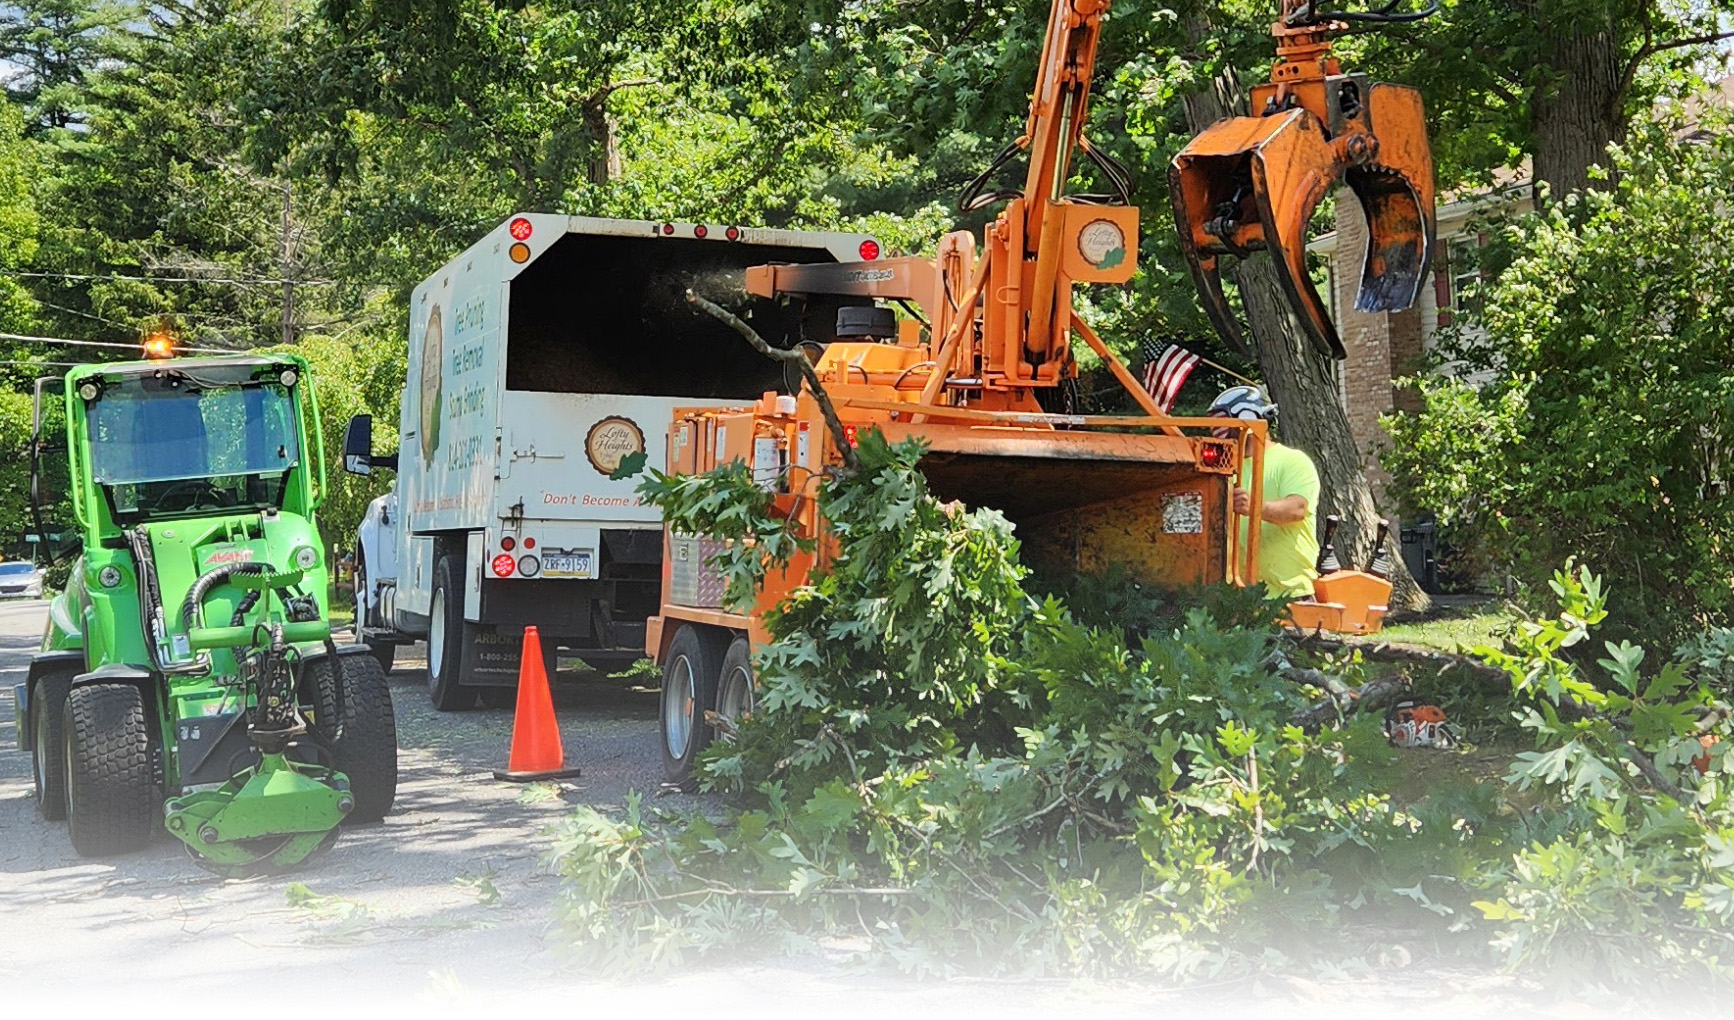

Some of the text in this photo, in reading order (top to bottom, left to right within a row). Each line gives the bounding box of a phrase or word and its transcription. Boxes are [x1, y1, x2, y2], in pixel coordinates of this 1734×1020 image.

[454, 296, 485, 335] Tree Pruning
[452, 348, 462, 376] Tree
[463, 336, 485, 372] Removal
[599, 426, 630, 441] Lofty
[595, 439, 634, 452] Heights
[582, 494, 630, 506] Become
